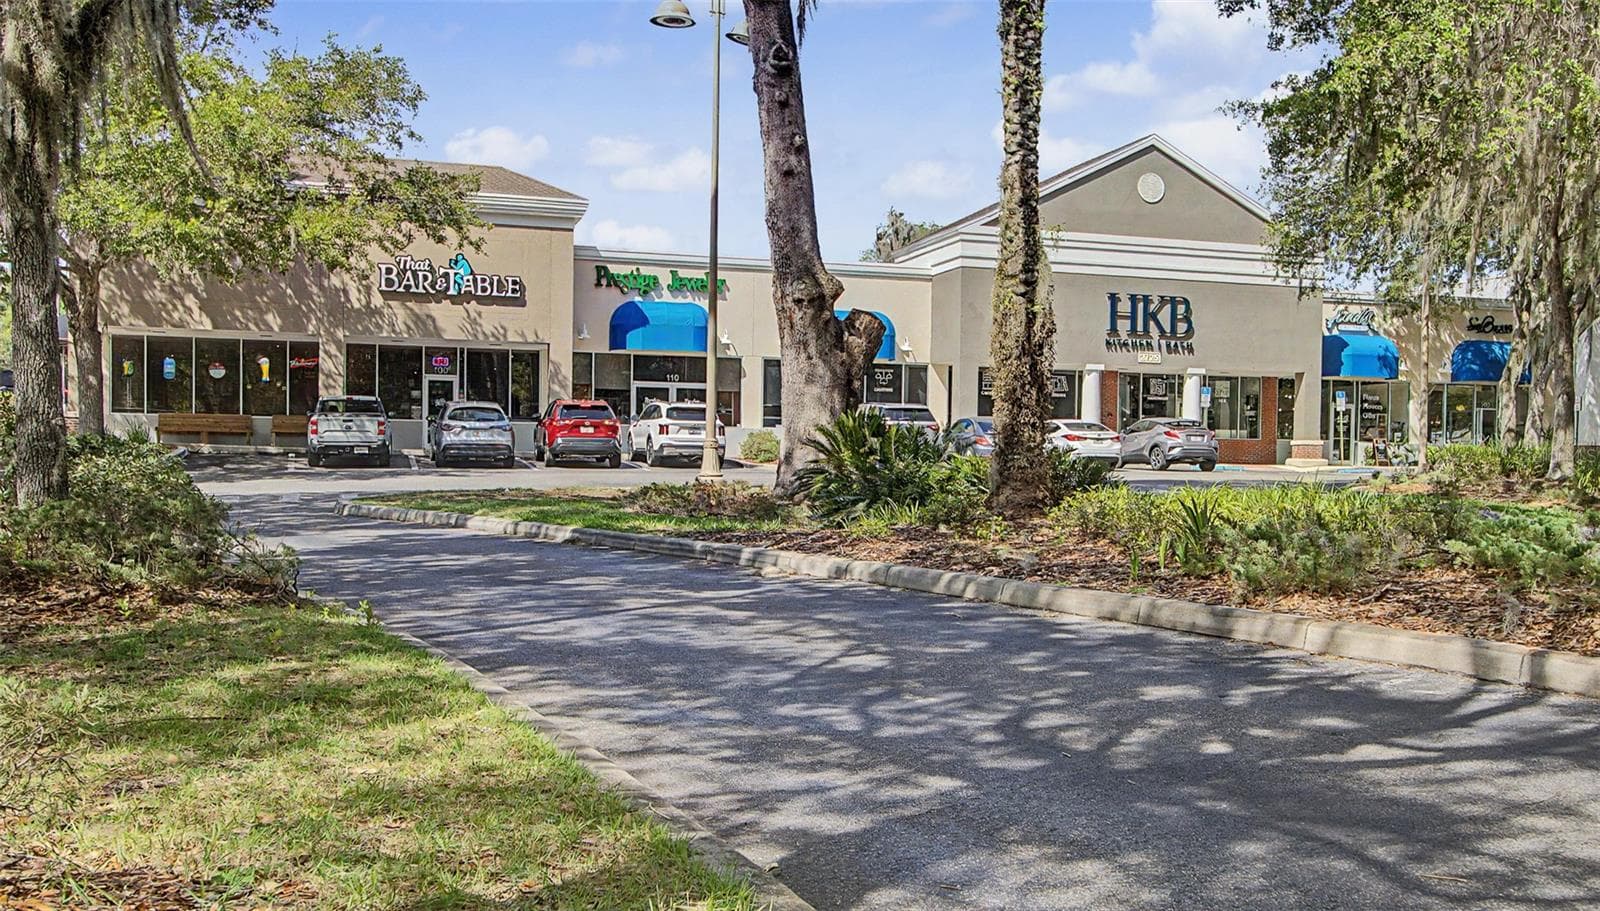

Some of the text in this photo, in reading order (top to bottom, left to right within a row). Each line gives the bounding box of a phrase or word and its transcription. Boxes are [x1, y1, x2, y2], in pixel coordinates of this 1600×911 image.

[396, 256, 432, 270] That
[594, 265, 660, 296] Prestige
[1106, 293, 1193, 336] HKB
[1105, 338, 1193, 351] KITCHEN BATH
[666, 374, 680, 382] 110
